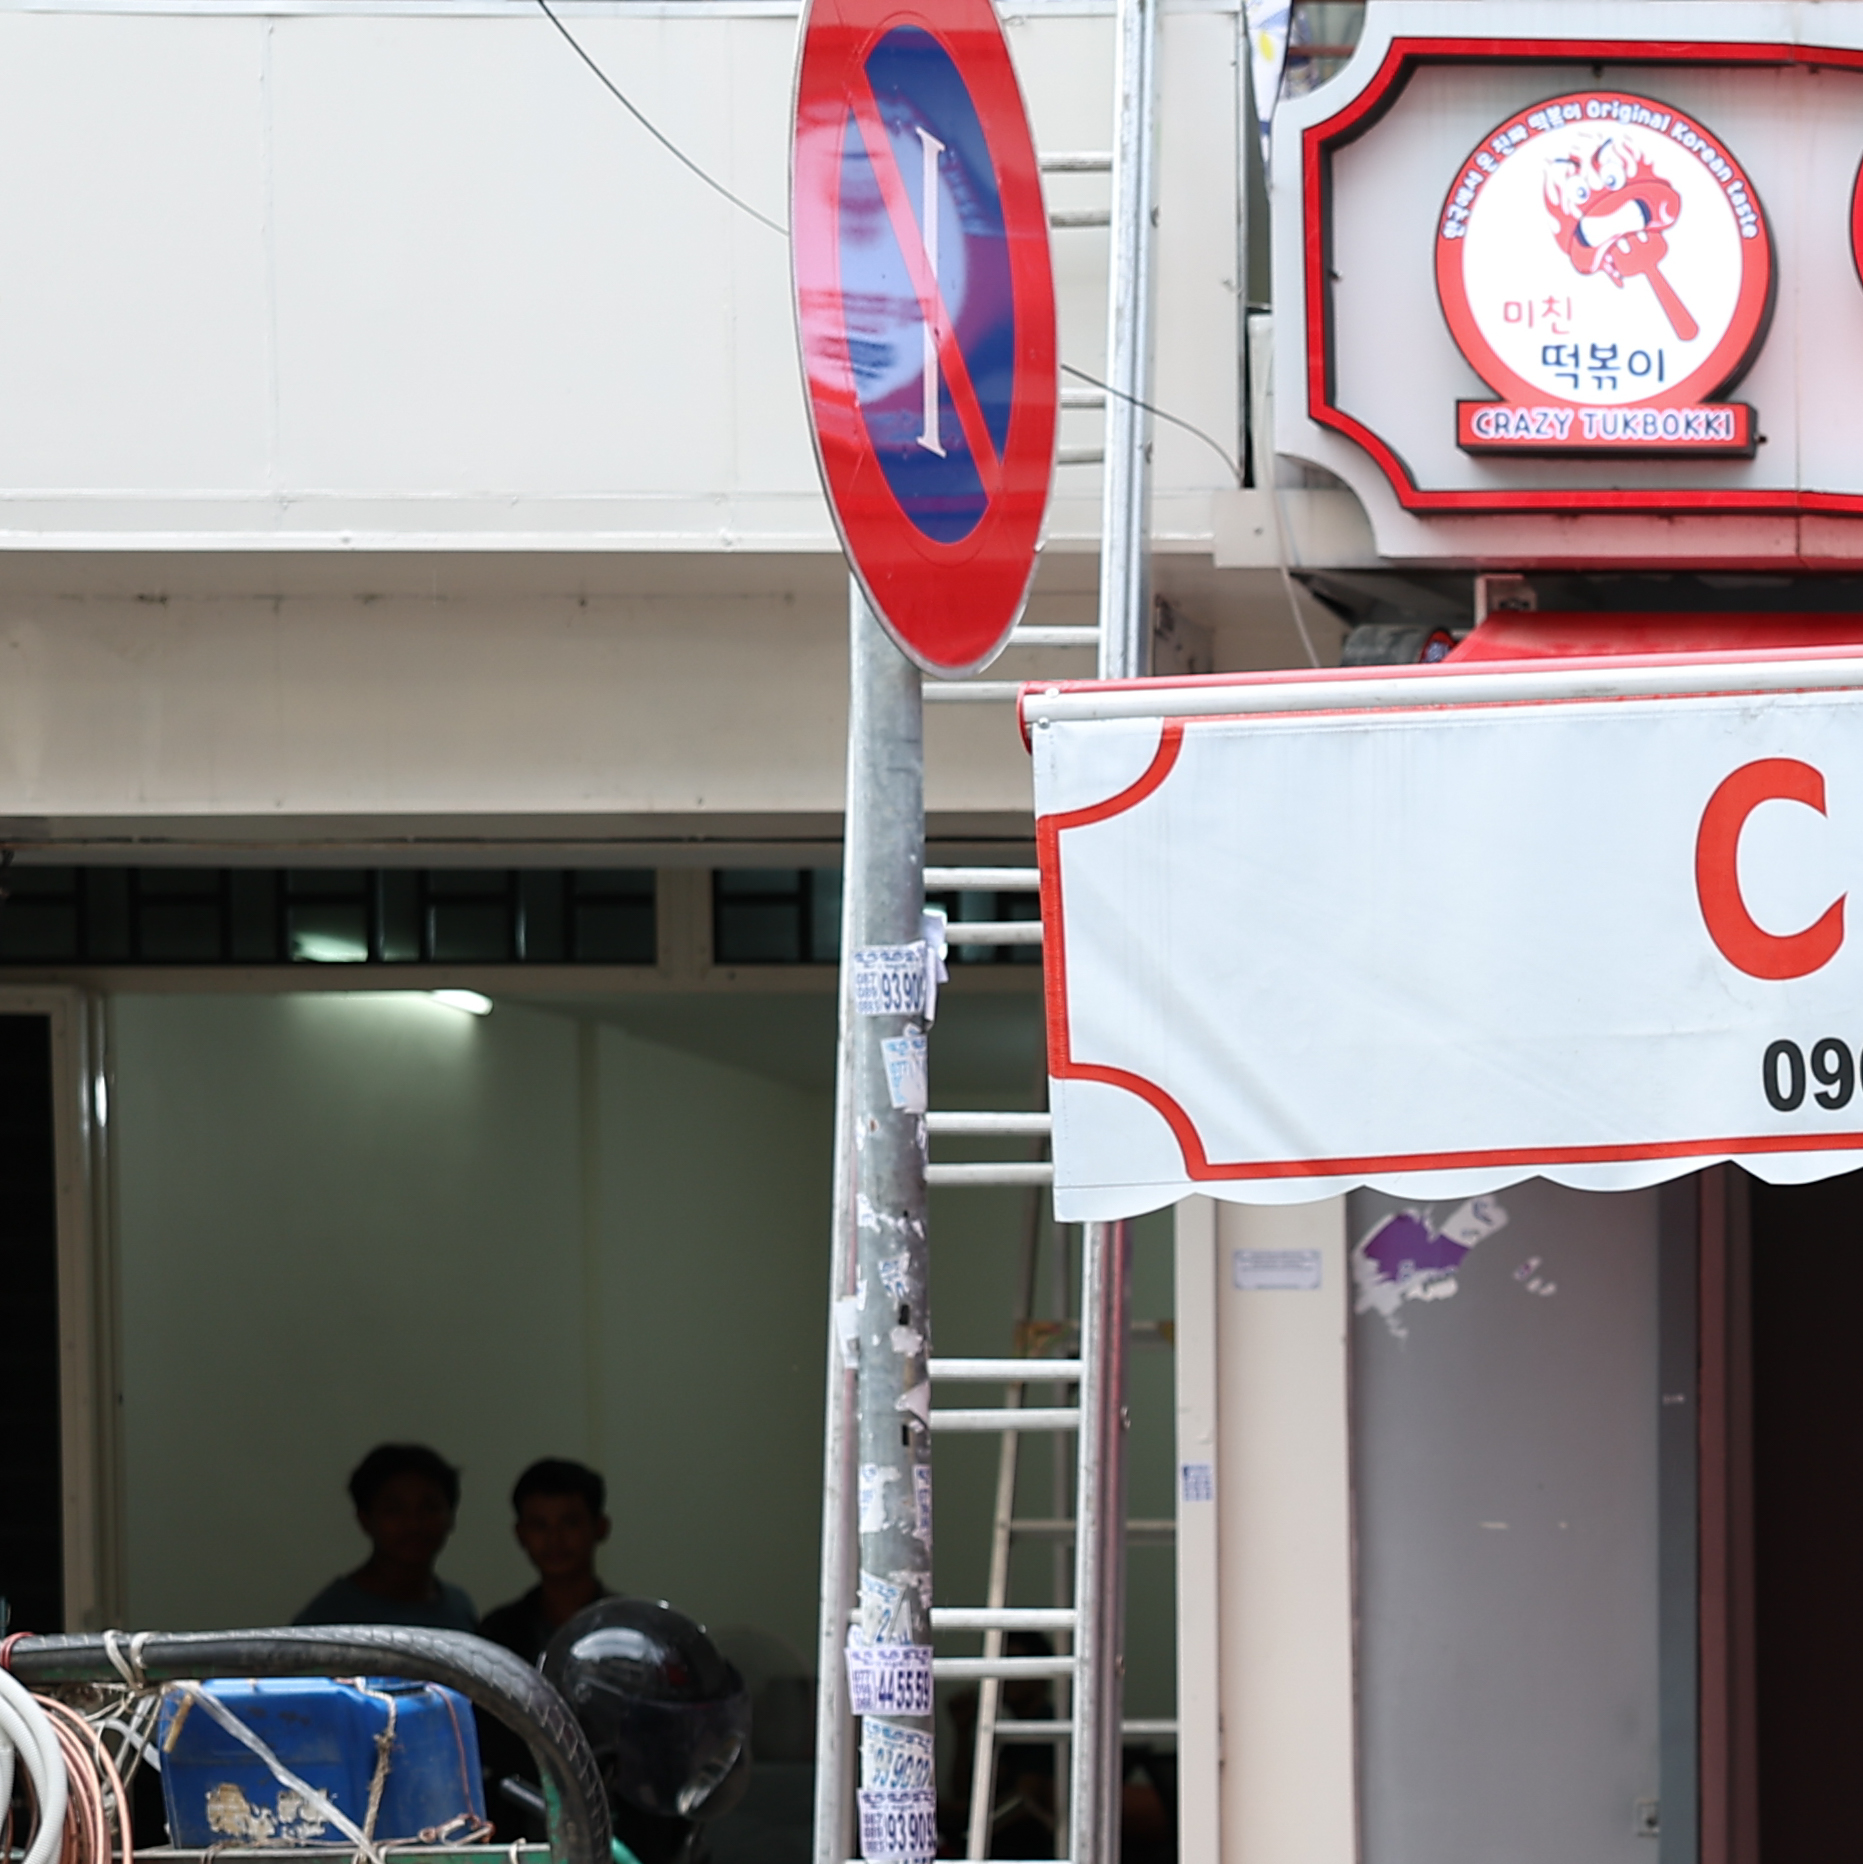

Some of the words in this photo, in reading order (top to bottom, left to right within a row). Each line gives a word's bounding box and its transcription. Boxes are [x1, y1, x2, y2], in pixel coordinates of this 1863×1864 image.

[1441, 171, 1483, 239] 한국에서
[1476, 151, 1497, 173] 온
[1491, 125, 1529, 157] 진짜
[1528, 103, 1581, 133] 떡볶이
[1586, 99, 1672, 132] Original
[1670, 123, 1735, 182] Korean
[1726, 177, 1758, 240] taste
[1504, 296, 1571, 334] 미친
[1541, 343, 1665, 390] 떡볶이
[1475, 410, 1571, 437] CRAZY
[1583, 410, 1733, 437] TUKBOKKI
